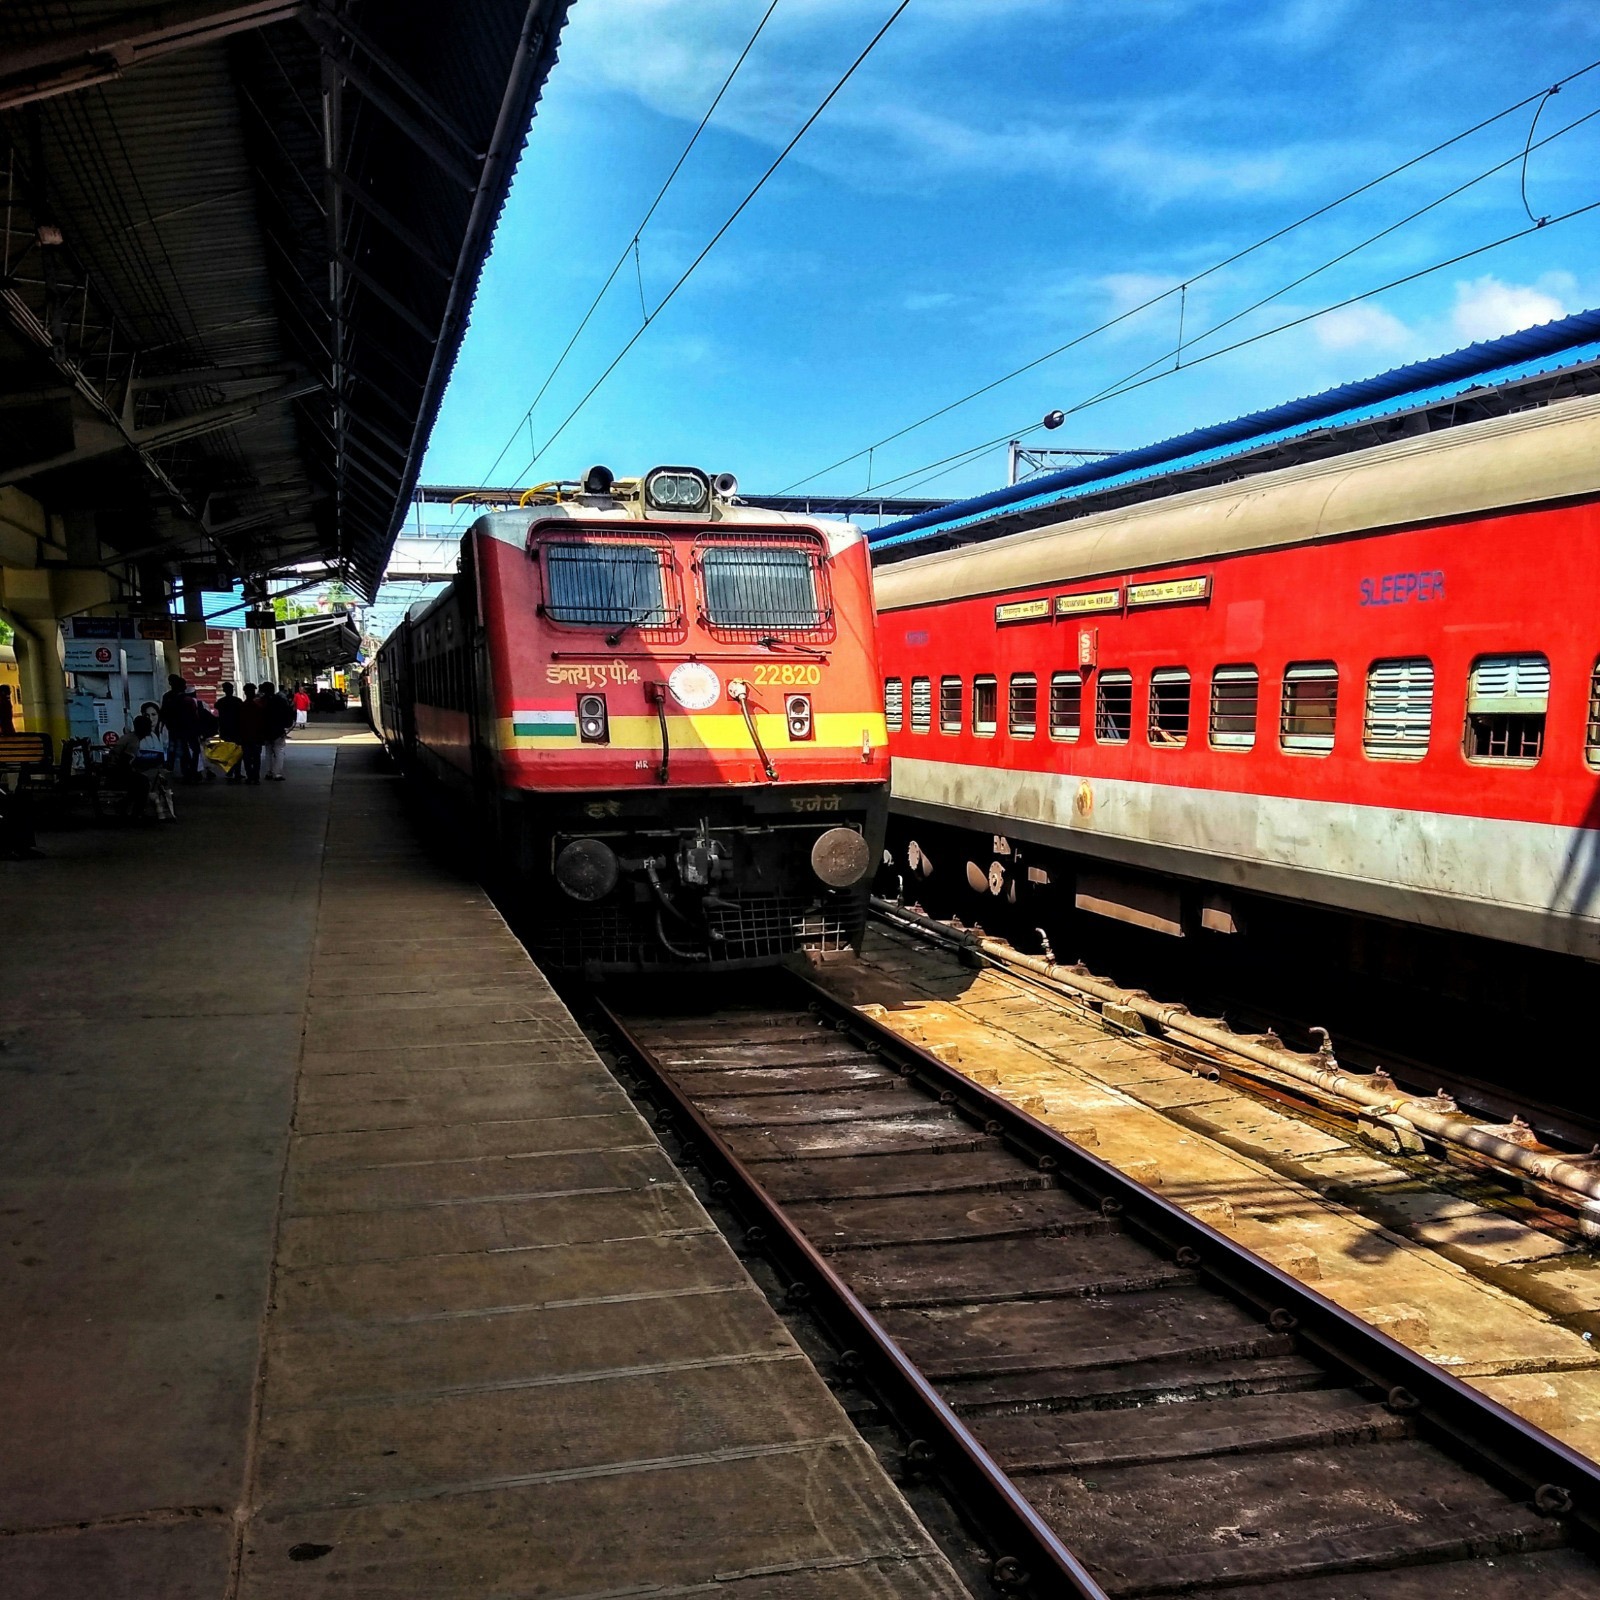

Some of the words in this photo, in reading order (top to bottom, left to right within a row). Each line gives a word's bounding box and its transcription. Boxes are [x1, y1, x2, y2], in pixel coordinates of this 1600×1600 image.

[1360, 571, 1444, 606] SLEEPER
[1080, 633, 1091, 663] S5
[753, 664, 821, 685] 22820
[635, 760, 649, 770] MR
